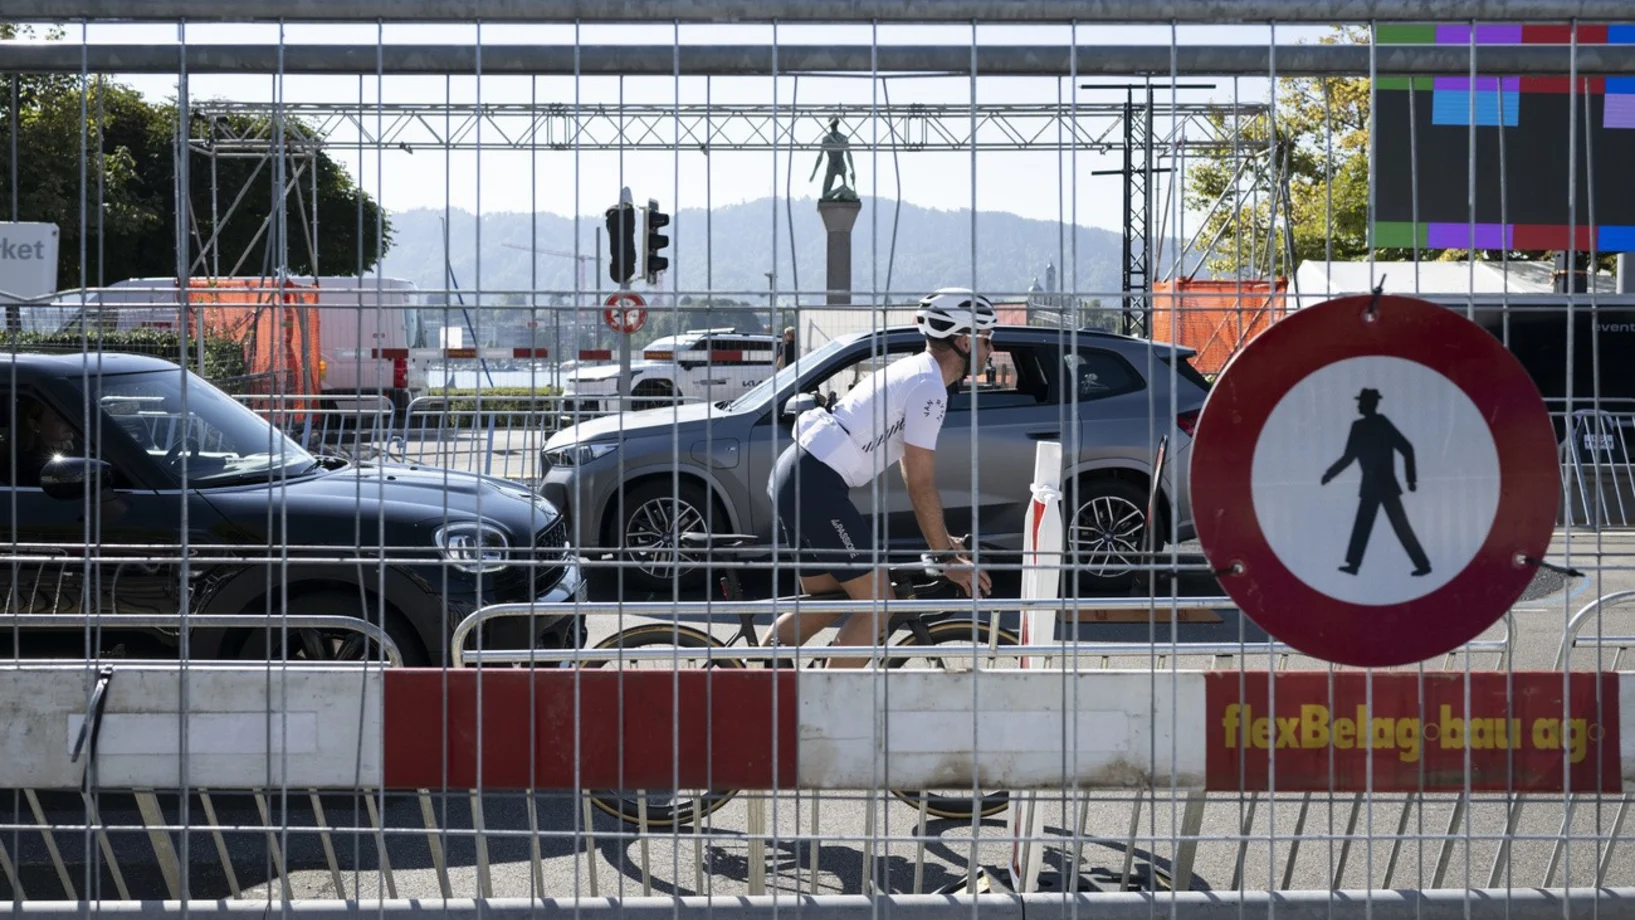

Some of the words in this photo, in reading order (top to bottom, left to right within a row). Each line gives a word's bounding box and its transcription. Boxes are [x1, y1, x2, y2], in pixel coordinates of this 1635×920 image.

[0, 238, 44, 260] ket
[1222, 703, 1421, 762] flexBelag
[1440, 704, 1521, 749] bau
[1532, 717, 1587, 763] ag
